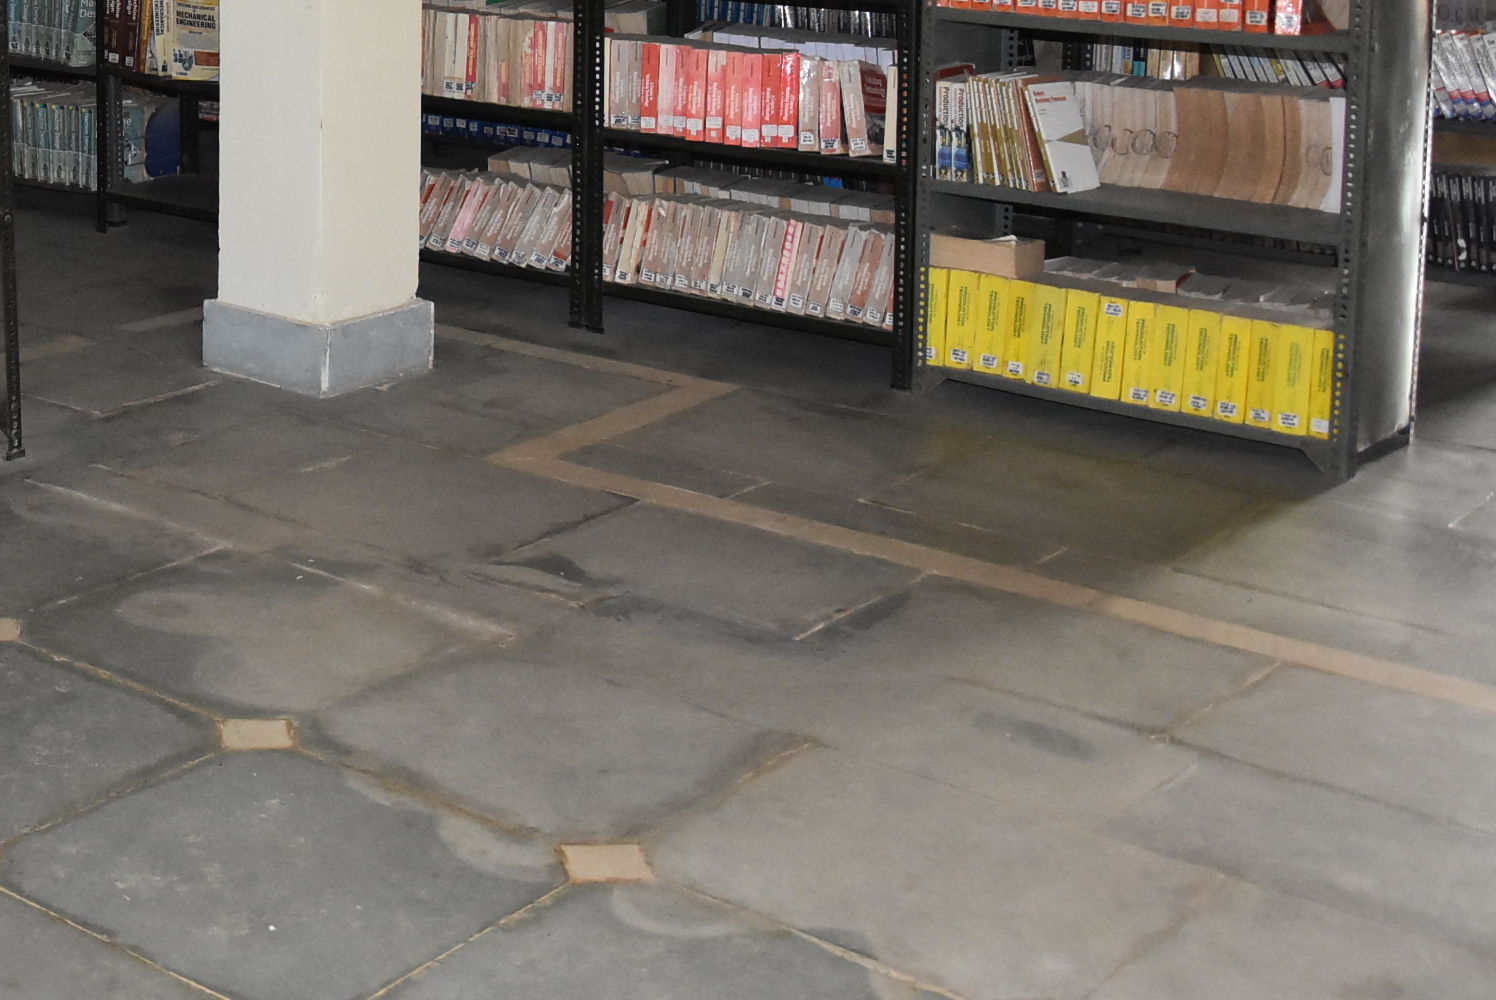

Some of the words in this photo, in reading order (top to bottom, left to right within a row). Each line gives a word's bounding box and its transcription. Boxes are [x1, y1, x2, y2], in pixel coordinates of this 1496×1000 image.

[176, 10, 216, 22] MECHANICAL
[176, 18, 216, 30] ENGINEERING
[942, 86, 950, 126] Production
